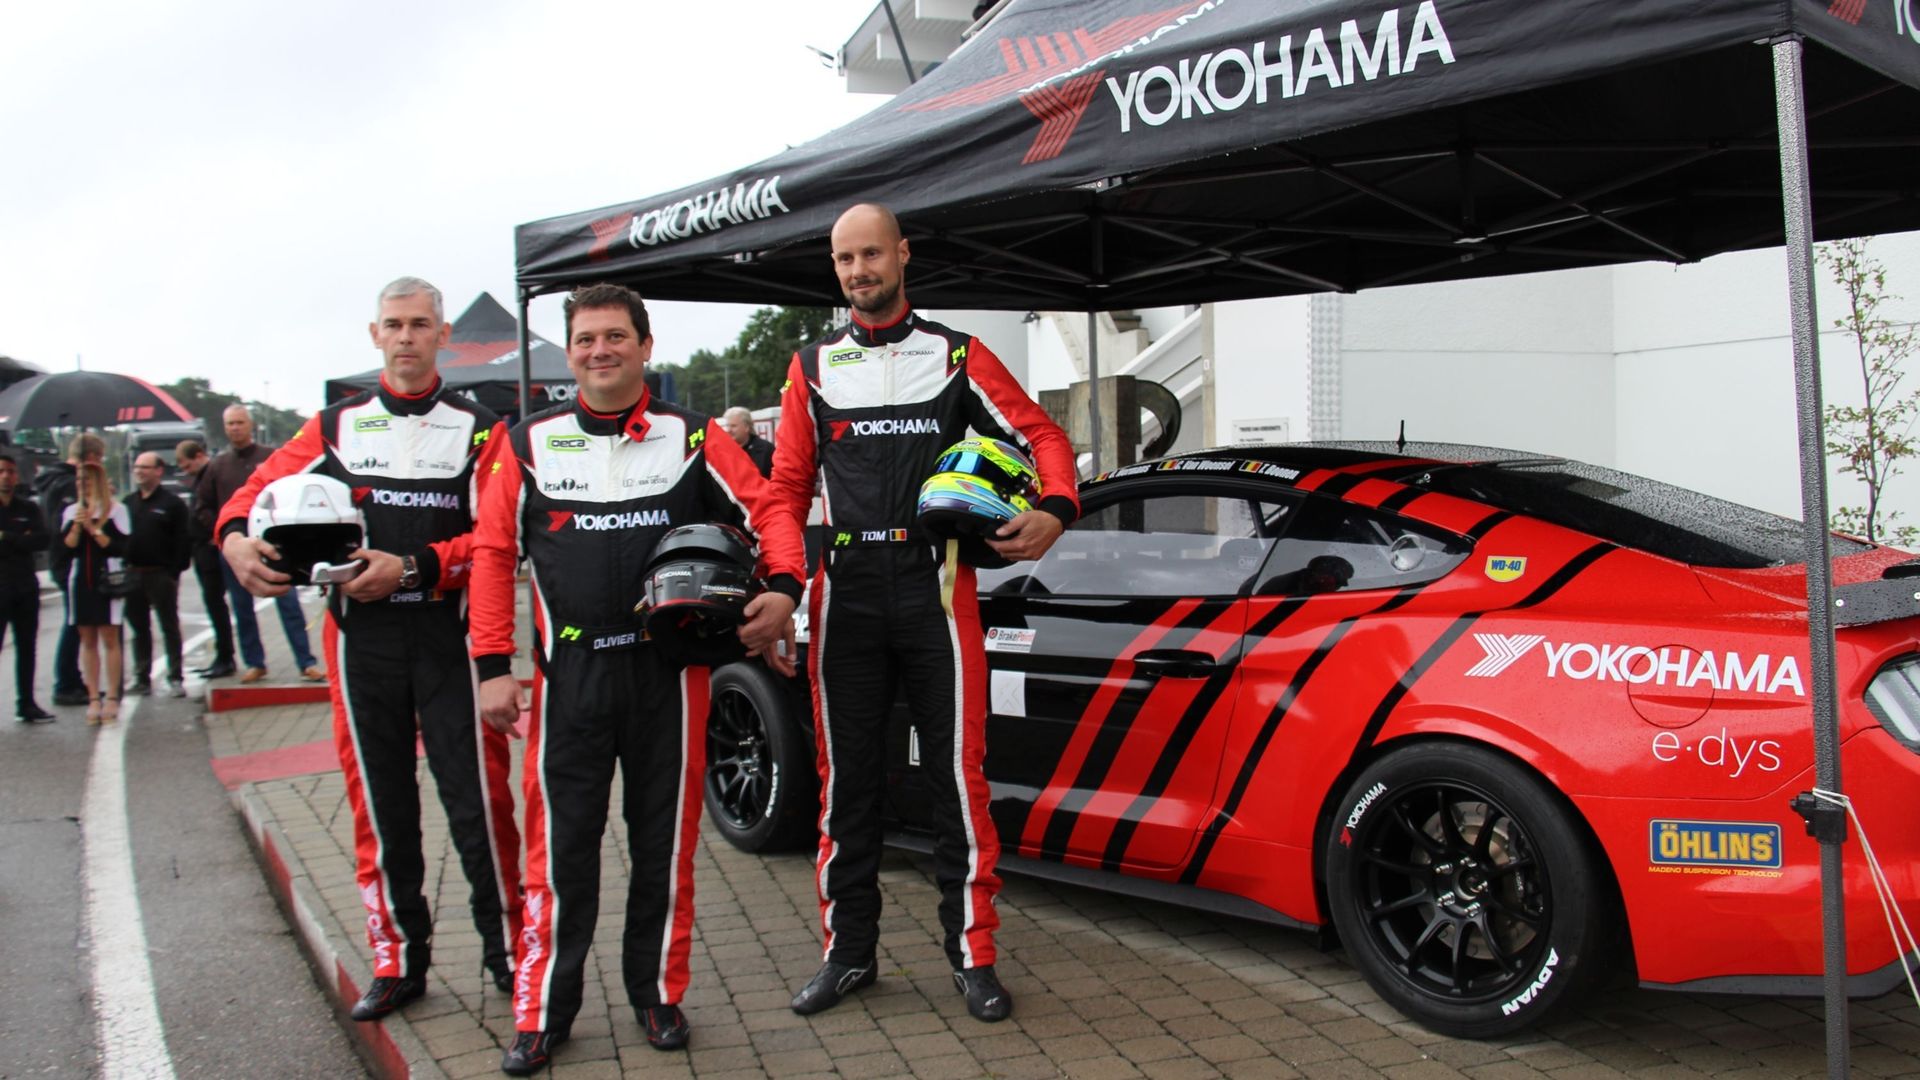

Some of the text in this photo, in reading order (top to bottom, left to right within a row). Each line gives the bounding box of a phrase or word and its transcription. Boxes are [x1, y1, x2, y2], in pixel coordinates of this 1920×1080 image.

[1105, 0, 1456, 133] YOKOHAMA
[629, 176, 790, 249] YOKOHAMA
[851, 418, 940, 436] YOKOHAMA
[372, 489, 459, 509] YOKOHAMA
[573, 509, 670, 530] YOKOHAMA
[861, 531, 886, 542] TOM
[1491, 559, 1521, 571] WD-40
[390, 592, 422, 602] CHRIS
[593, 632, 636, 650] OLIVIER
[1543, 642, 1805, 696] YOKOHAMA
[1346, 782, 1387, 829] YOKOHAMA
[1659, 823, 1773, 862] ÖHLINS
[1683, 867, 1731, 876] SUSPENSION
[1733, 869, 1784, 878] TECHNOLOGY
[1501, 947, 1560, 1016] ADVAN
